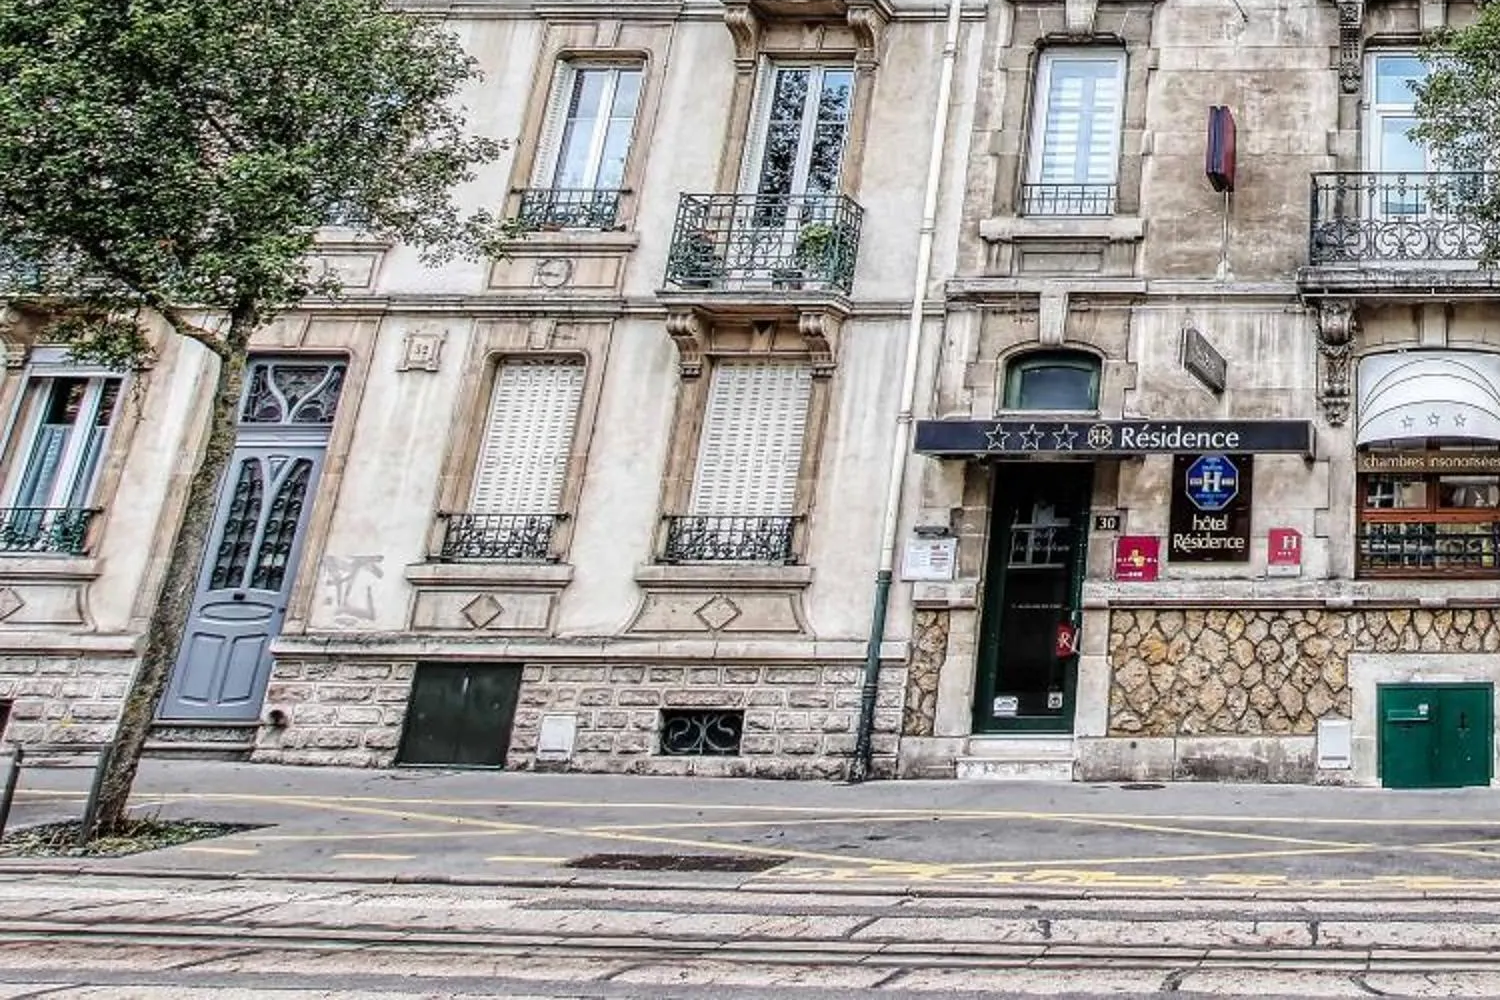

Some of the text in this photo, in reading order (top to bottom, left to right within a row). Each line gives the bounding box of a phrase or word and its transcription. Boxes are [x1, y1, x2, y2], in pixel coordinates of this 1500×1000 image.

[1121, 424, 1240, 449] Résidence
[1363, 453, 1425, 468] chambres
[1099, 517, 1117, 529] 30
[1192, 514, 1229, 531] hôtel
[1173, 532, 1245, 551] Résidence
